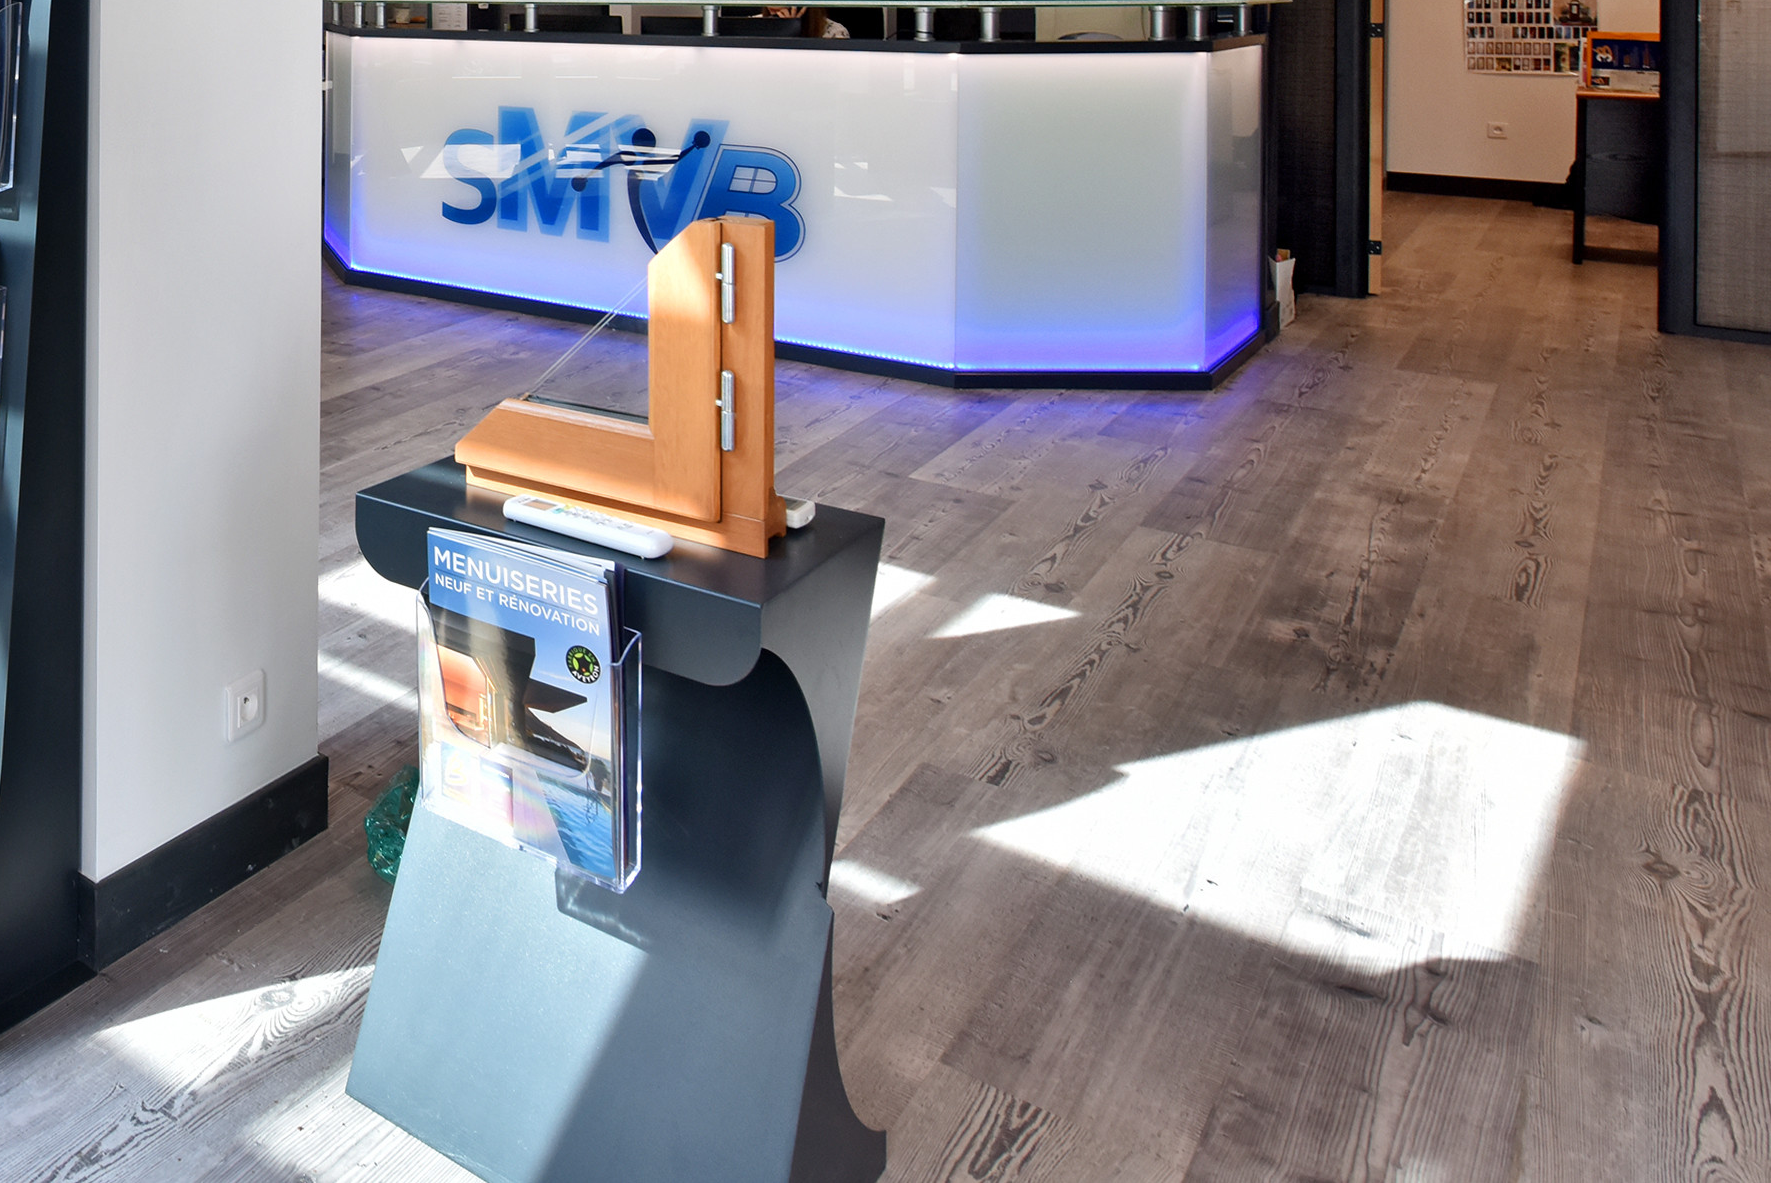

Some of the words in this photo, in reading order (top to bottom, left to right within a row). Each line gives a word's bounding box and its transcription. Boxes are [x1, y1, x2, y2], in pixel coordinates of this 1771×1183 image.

[442, 105, 806, 263] SMVB
[434, 546, 599, 615] MENUISERIES
[435, 573, 472, 595] NEUF
[476, 588, 494, 603] ET
[499, 594, 600, 637] RÉNOVATION
